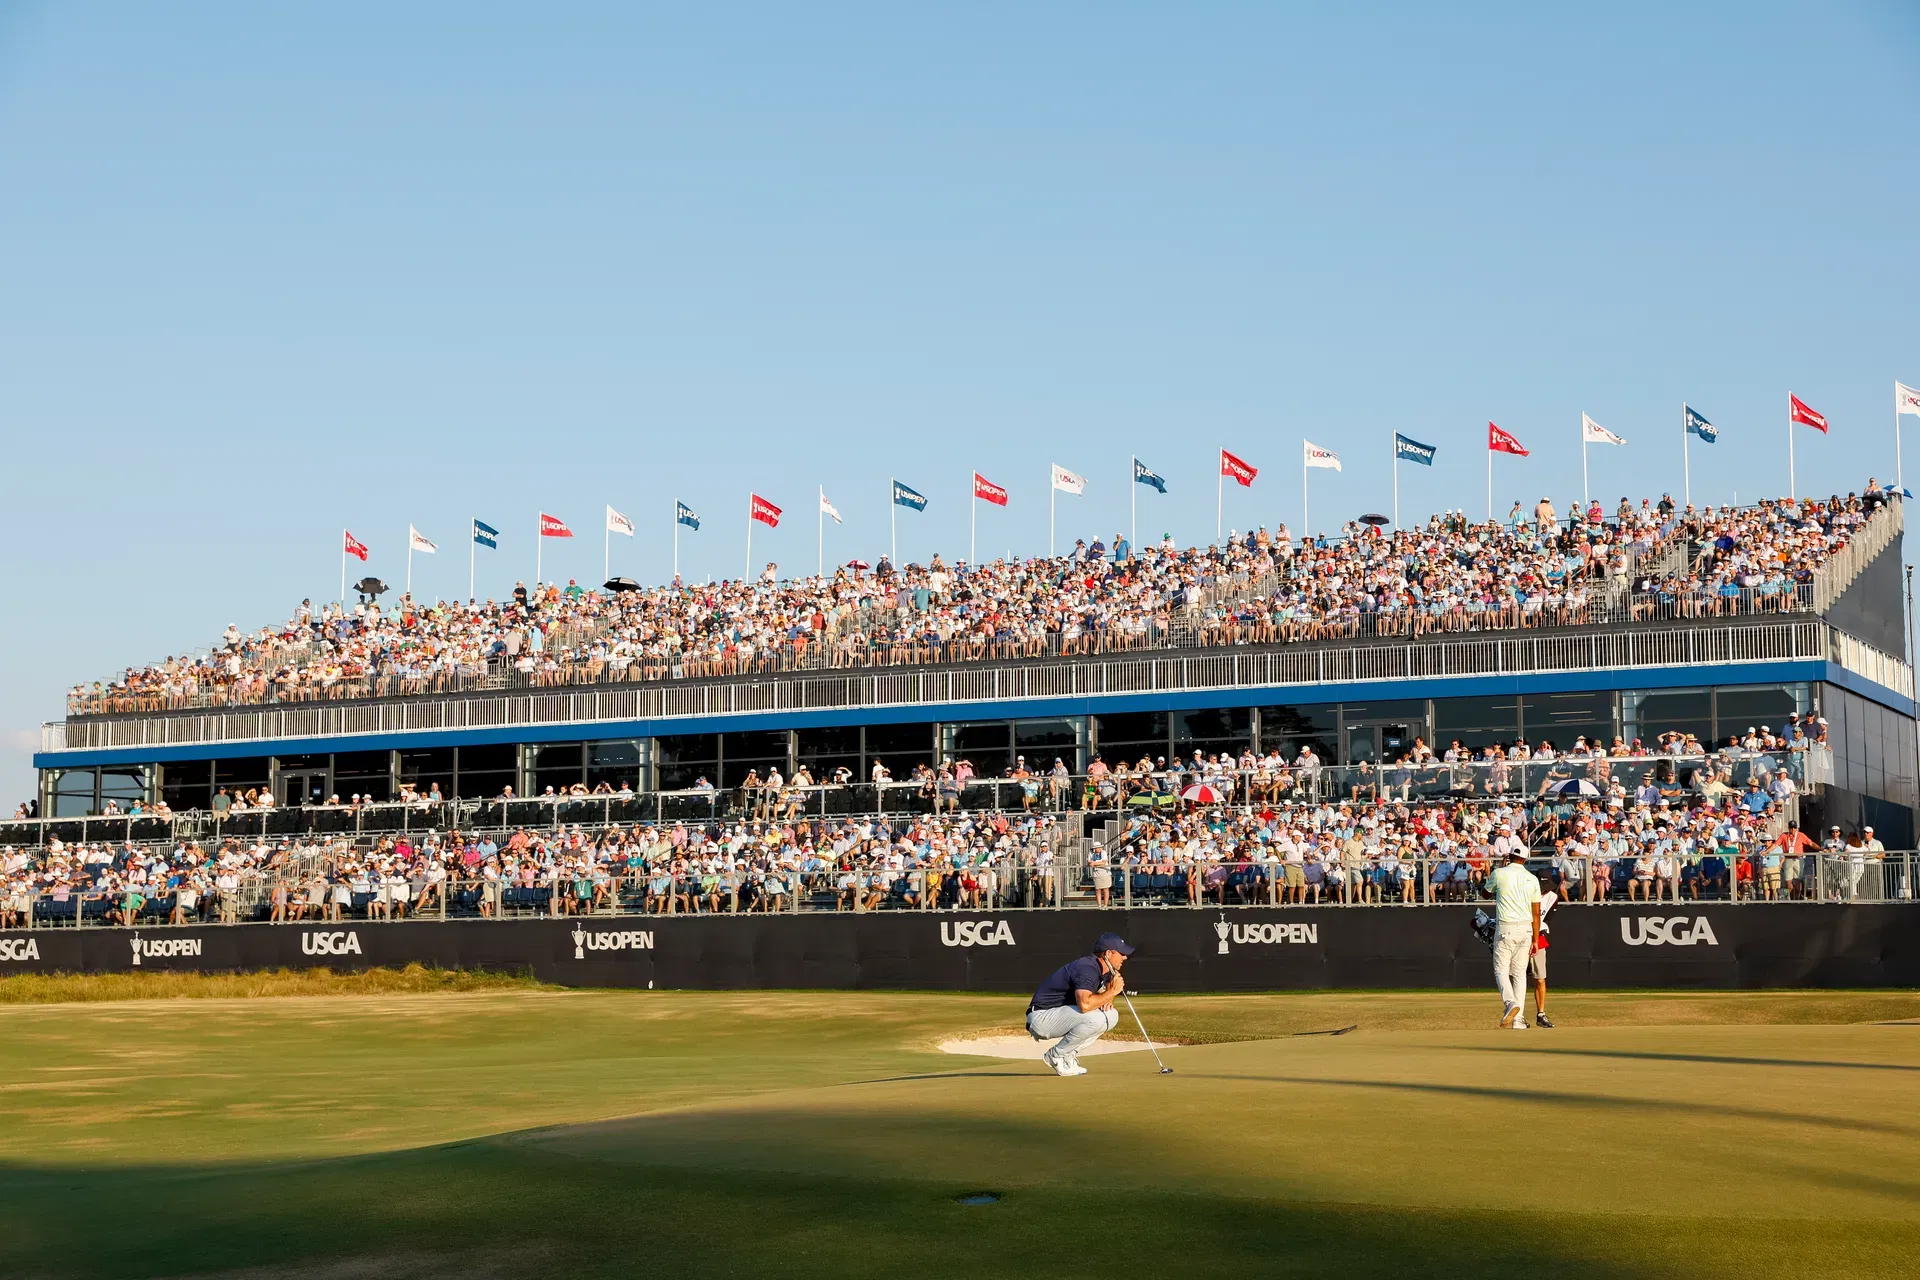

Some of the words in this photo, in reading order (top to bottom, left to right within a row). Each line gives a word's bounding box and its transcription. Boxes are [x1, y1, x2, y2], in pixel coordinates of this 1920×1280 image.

[587, 930, 654, 950] USOPEN
[940, 920, 1016, 947] USGA
[1232, 923, 1317, 944] USOPEN
[1619, 915, 1719, 945] USGA
[0, 938, 40, 961] SGA
[143, 938, 202, 957] USOPEN
[301, 931, 363, 955] USGA
